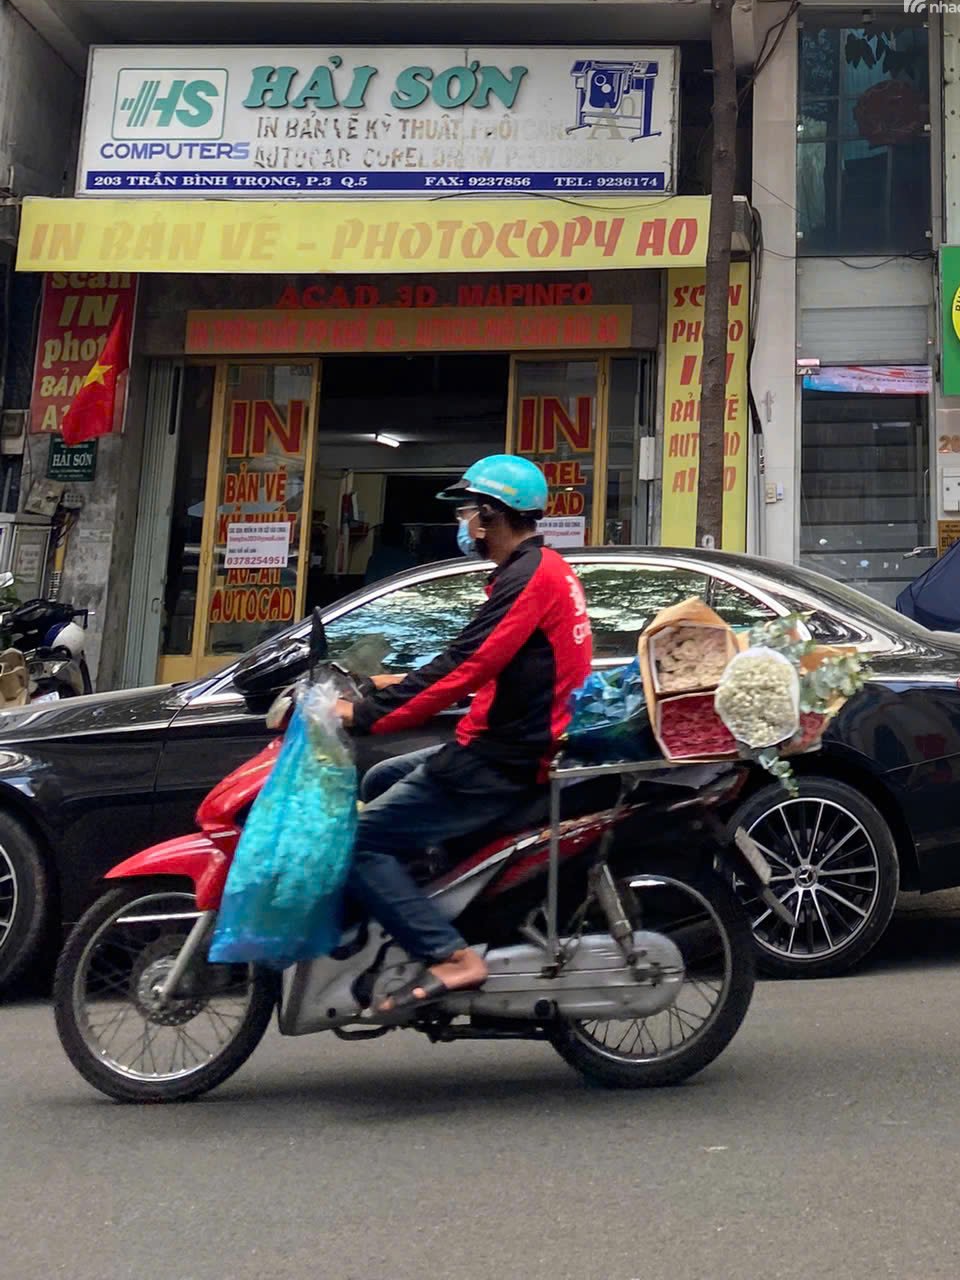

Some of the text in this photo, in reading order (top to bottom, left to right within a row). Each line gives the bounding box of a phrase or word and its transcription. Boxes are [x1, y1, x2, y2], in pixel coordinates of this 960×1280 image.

[242, 55, 529, 110] HẢI SƠN
[100, 142, 250, 160] COMPUTERS
[94, 171, 658, 189] 203 TRẦN BÌNH TRỌNG, P.3 Q.5 FAX: 9237856 TEL: 9236174
[29, 222, 86, 261] IN
[99, 212, 206, 261] BẢN
[219, 215, 282, 261] VẼ
[331, 216, 625, 259] PHOTOCOPY
[58, 294, 119, 327] IN
[456, 282, 593, 307] MAPINFO
[673, 284, 743, 308] SCN
[671, 320, 744, 343] PHO
[43, 331, 108, 369] phot
[228, 400, 305, 458] IN
[516, 395, 593, 454] IN
[223, 461, 288, 504] BẢN VẼ
[226, 556, 286, 566] 0378254951
[208, 587, 295, 623] AUTOCAD
